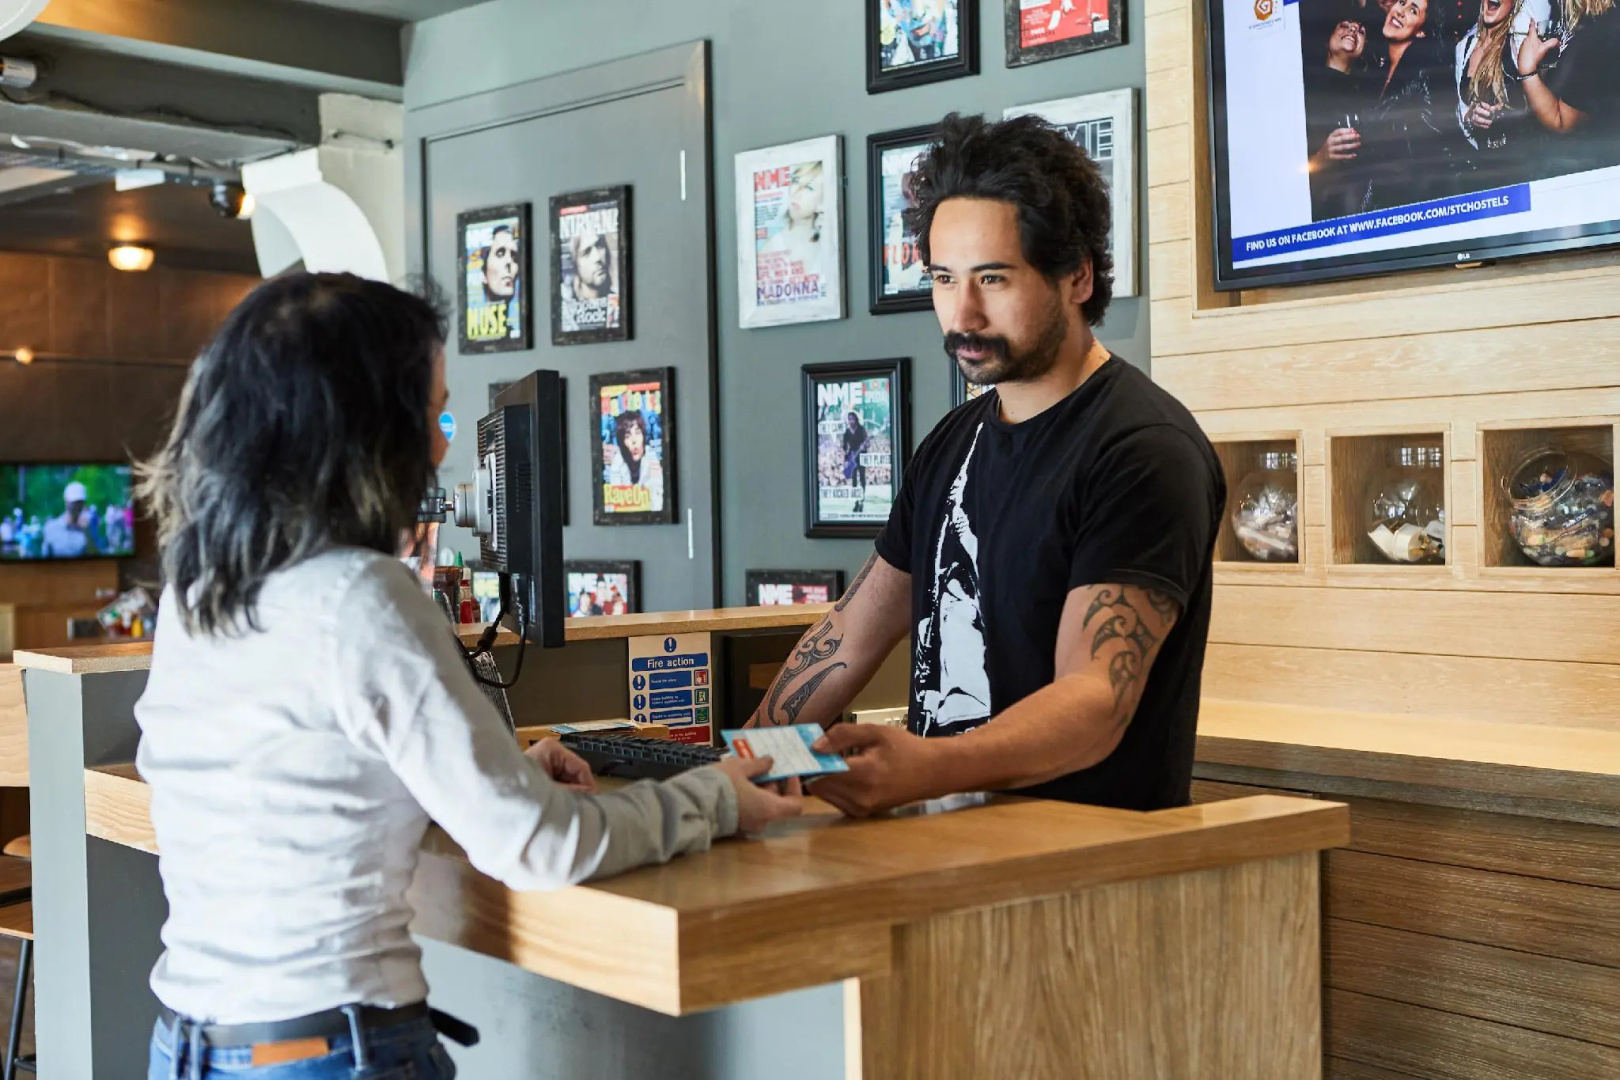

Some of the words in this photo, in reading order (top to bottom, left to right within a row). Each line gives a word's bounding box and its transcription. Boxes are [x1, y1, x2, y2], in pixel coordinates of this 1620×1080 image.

[753, 166, 791, 192] NME
[1246, 240, 1266, 251] FIND
[1266, 237, 1277, 247] US
[1278, 236, 1291, 246] ON
[1291, 227, 1336, 243] FACEBOOK
[1336, 224, 1349, 235] AT
[1349, 195, 1509, 233] WWW.FACEBOOK.COM/STCHOSTELS
[756, 280, 819, 302] MADONNA
[466, 302, 508, 340] MUSE
[817, 382, 863, 407] NME
[758, 583, 793, 605] NME
[647, 658, 663, 669] Fire
[667, 657, 694, 667] action
